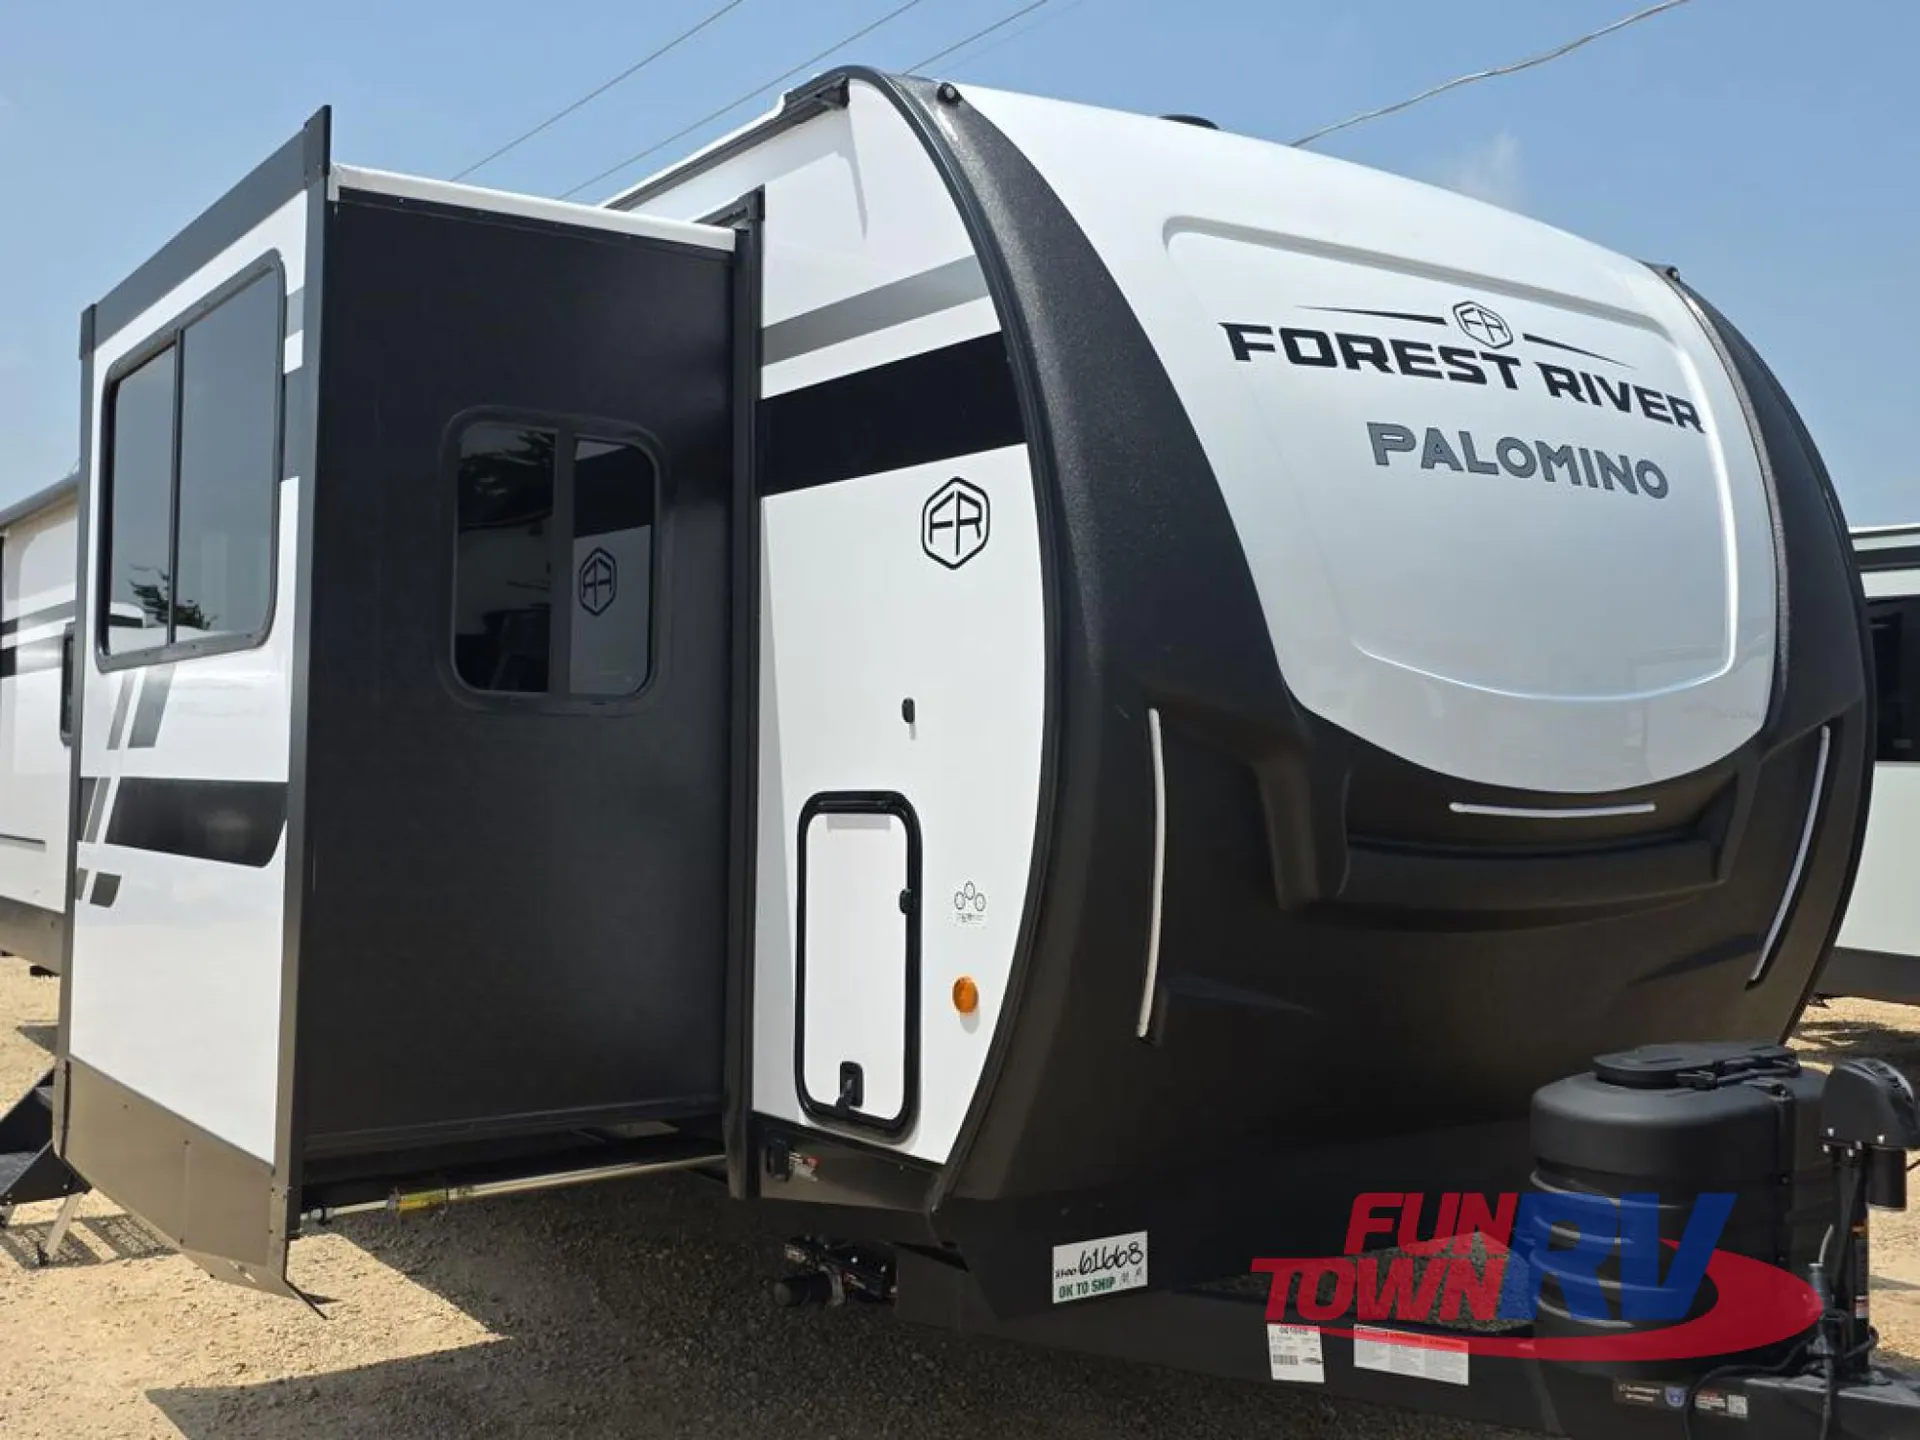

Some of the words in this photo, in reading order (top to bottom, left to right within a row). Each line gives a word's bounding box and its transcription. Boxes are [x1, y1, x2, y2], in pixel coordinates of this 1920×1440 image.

[1218, 321, 1521, 390] FOREST
[1535, 361, 1706, 433] RIVER
[1366, 421, 1669, 499] PALOMINO
[1059, 1284, 1073, 1298] OK
[1076, 1281, 1089, 1296] TO
[1092, 1276, 1116, 1292] SHIP
